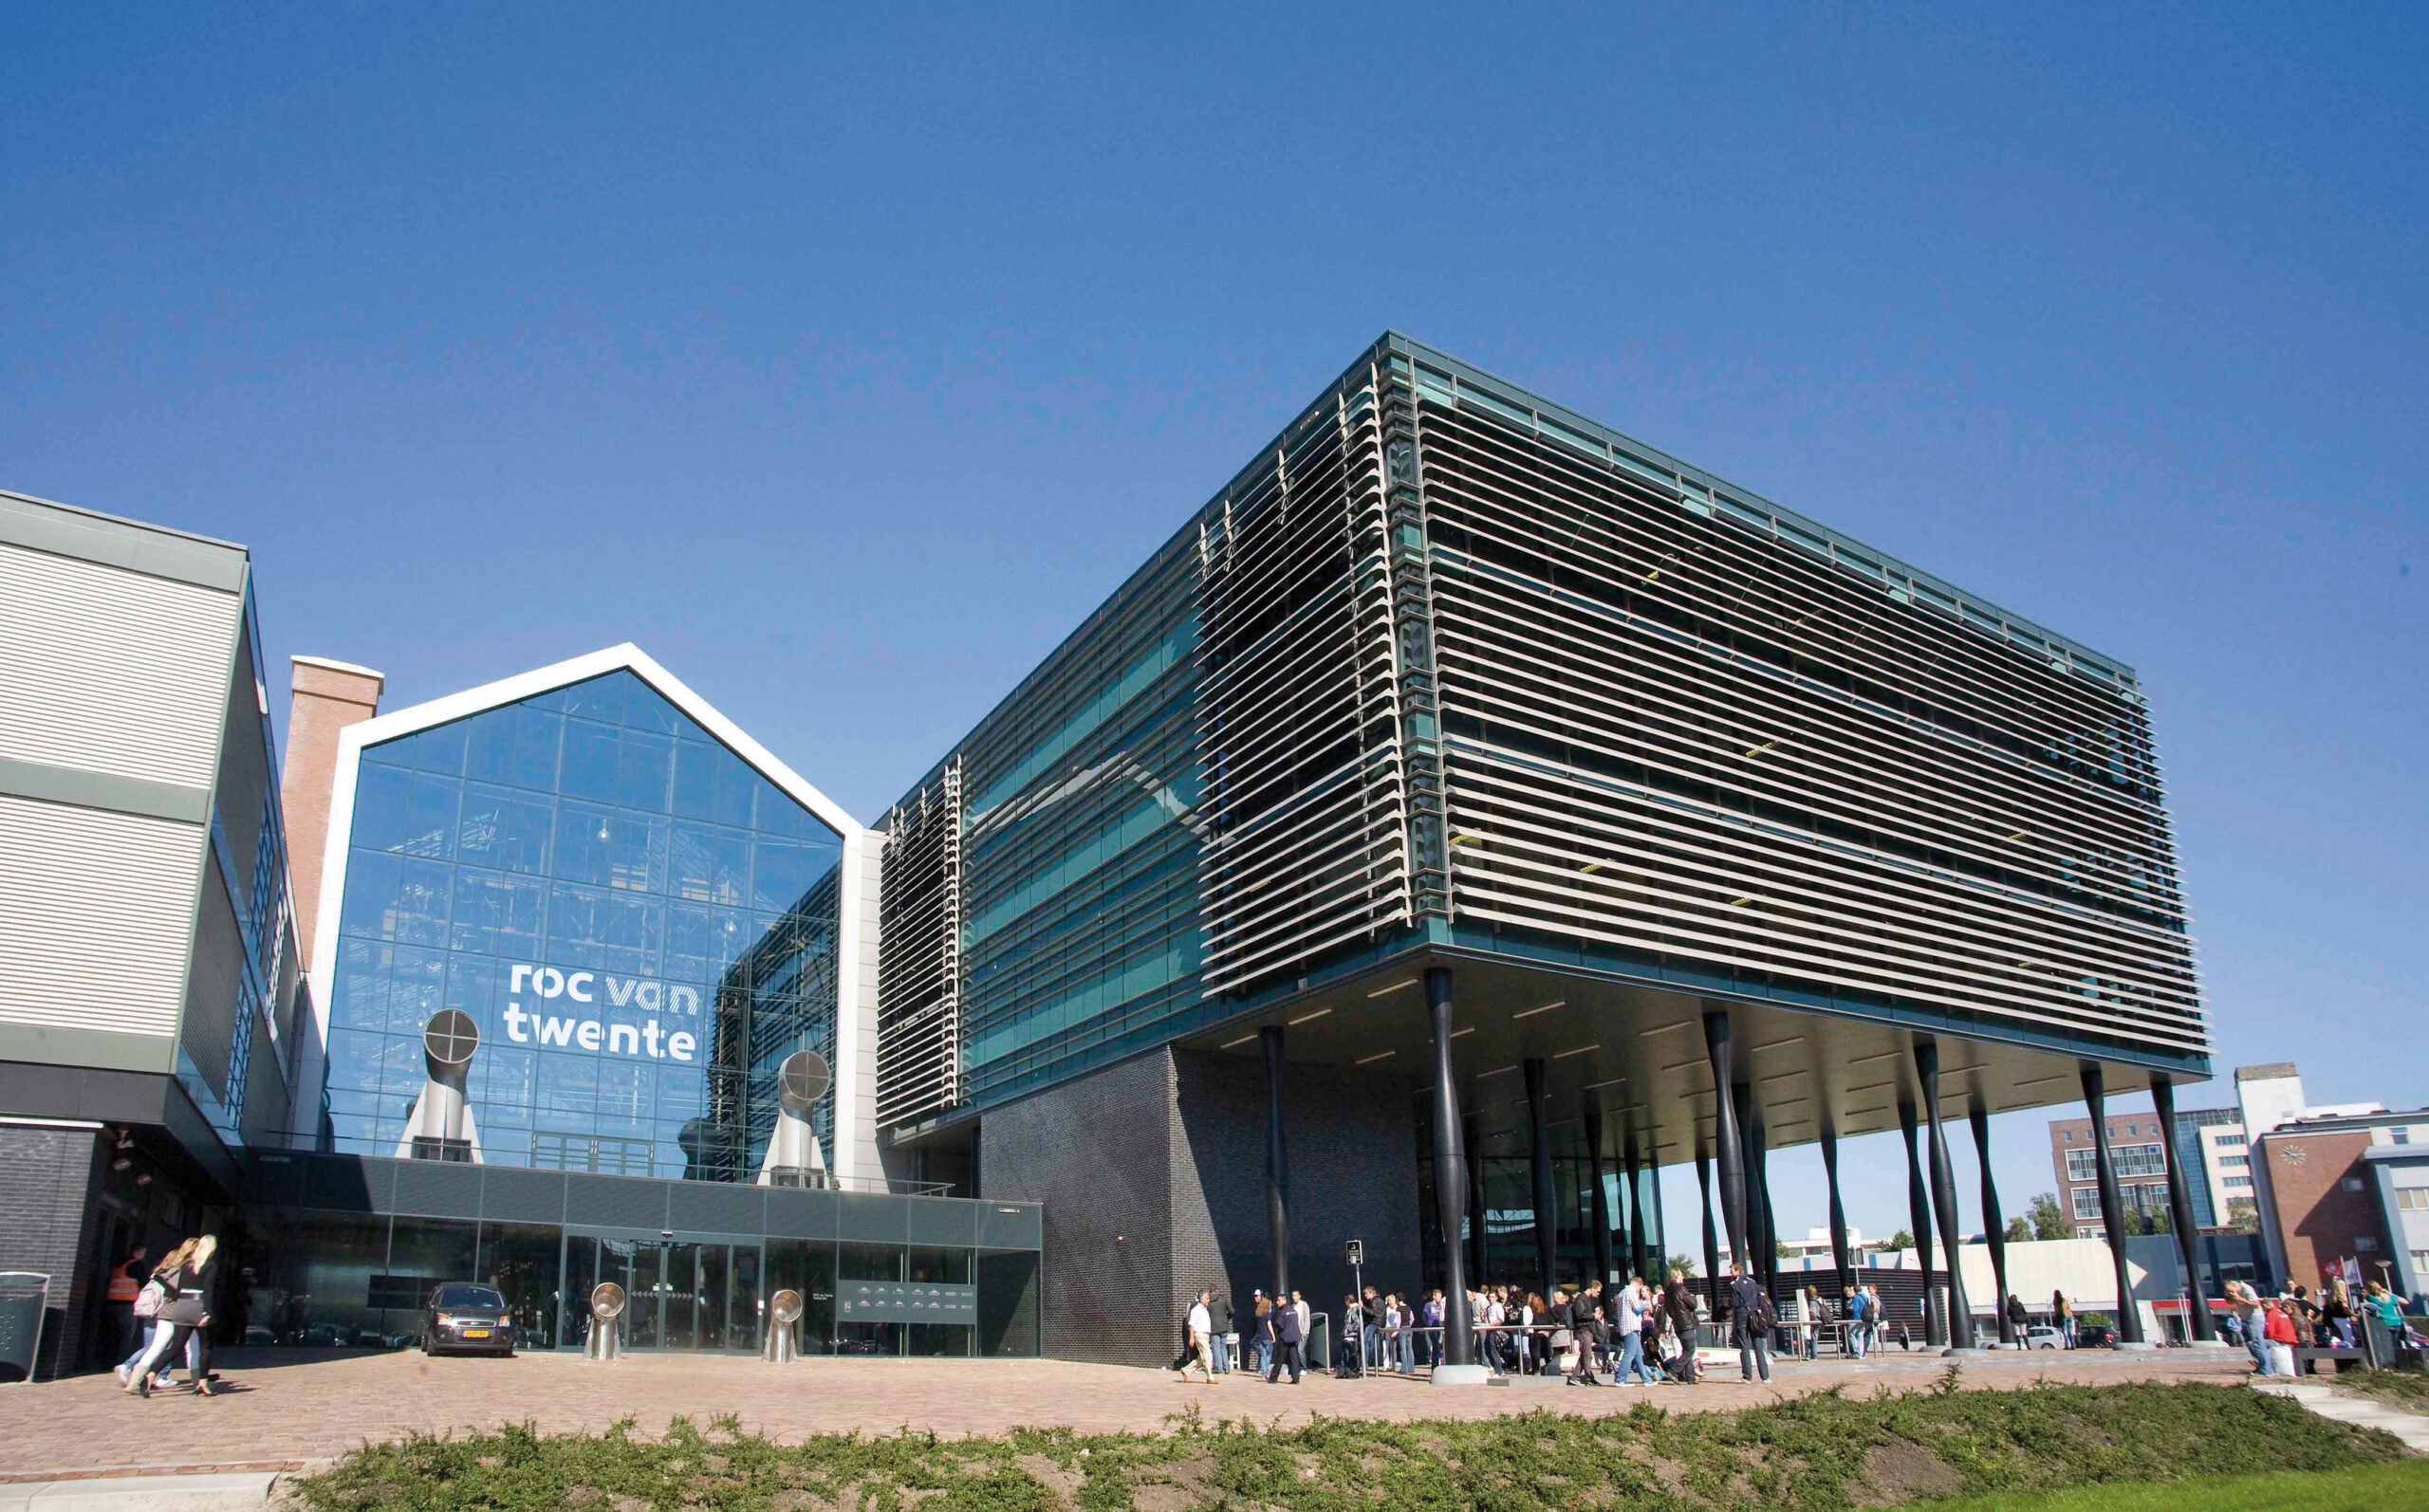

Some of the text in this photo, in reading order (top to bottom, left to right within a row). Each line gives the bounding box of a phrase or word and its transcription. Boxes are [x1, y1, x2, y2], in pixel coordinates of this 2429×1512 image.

[510, 964, 698, 1016] roc van
[503, 1002, 695, 1060] twente
